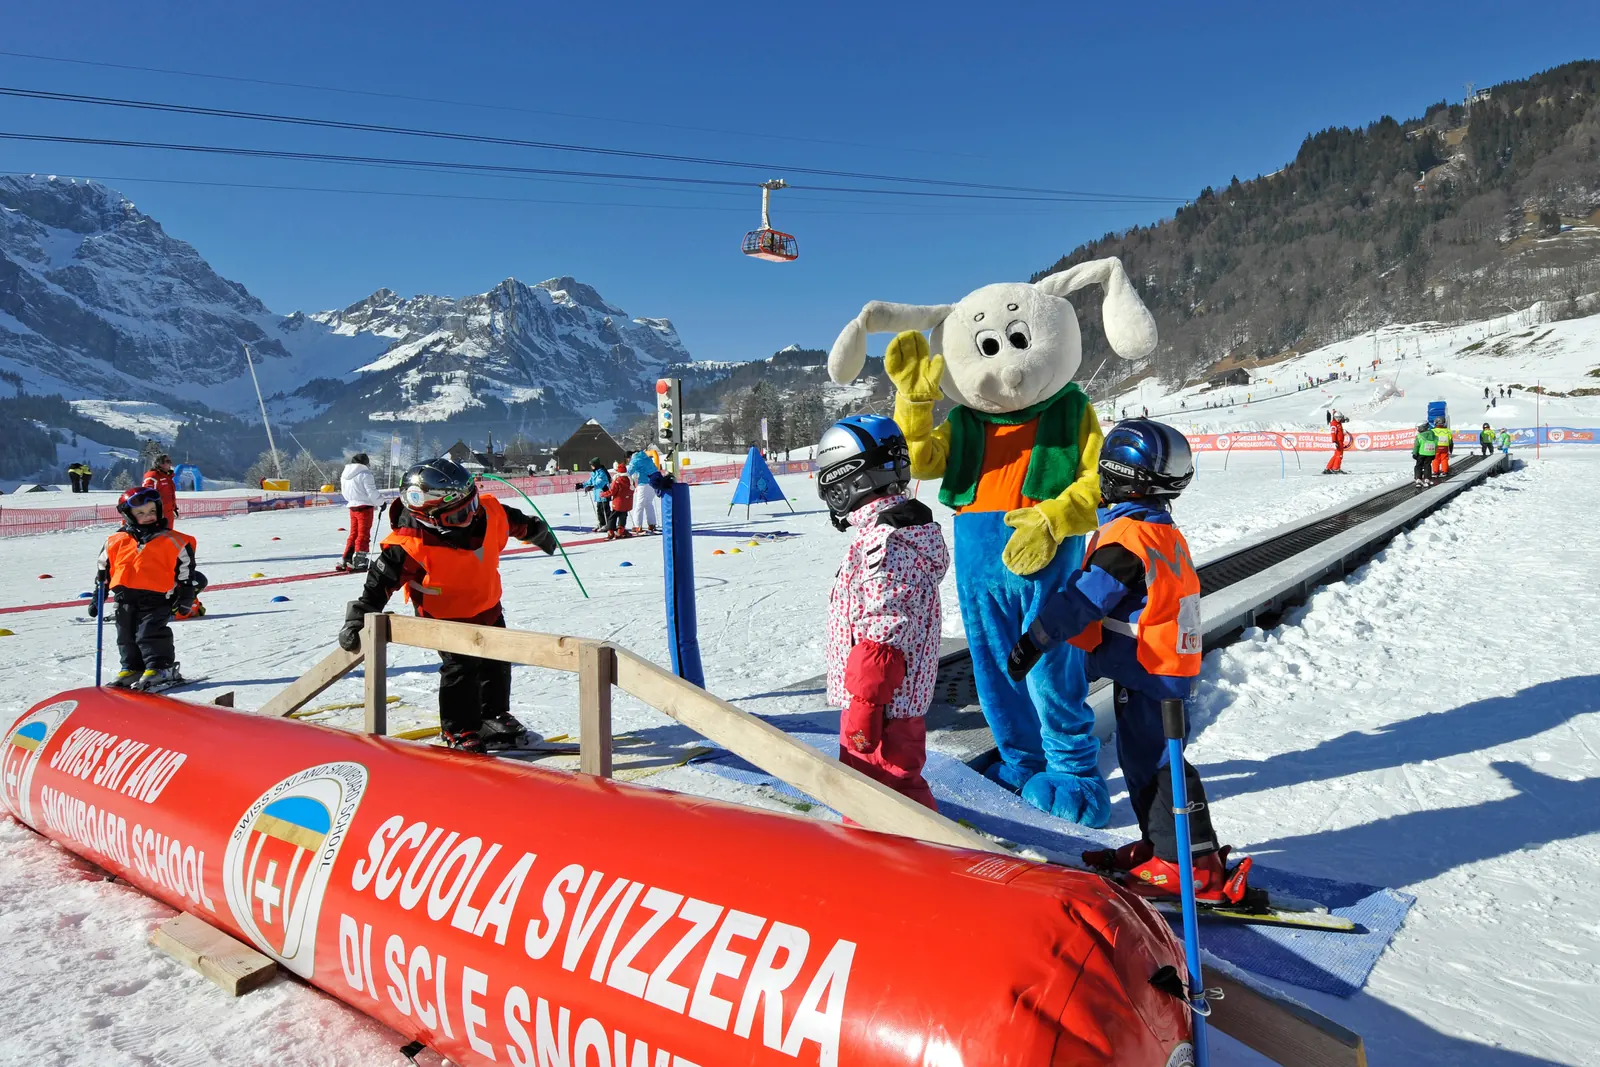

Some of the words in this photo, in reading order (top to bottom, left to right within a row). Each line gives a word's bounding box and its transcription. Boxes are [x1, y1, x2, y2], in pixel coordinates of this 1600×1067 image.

[818, 445, 846, 456] ALPINA
[825, 463, 857, 483] ALPINA
[1104, 461, 1135, 476] ALPIN
[50, 726, 118, 780] SWISS
[93, 738, 150, 791] SKI
[120, 747, 187, 804] AND
[297, 765, 329, 783] AND
[273, 774, 298, 796] SKI
[326, 764, 363, 803] SNOWBOARD
[233, 793, 270, 841] SWISS
[319, 803, 355, 873] SCHOOL
[41, 784, 131, 868] SNOWBOARD
[132, 823, 216, 913] SCHOOL
[351, 815, 537, 946] SCUOLA
[524, 863, 857, 1067] SVIZZERA
[339, 913, 379, 1001] DI
[384, 934, 455, 1040] SCI
[462, 965, 497, 1062] E
